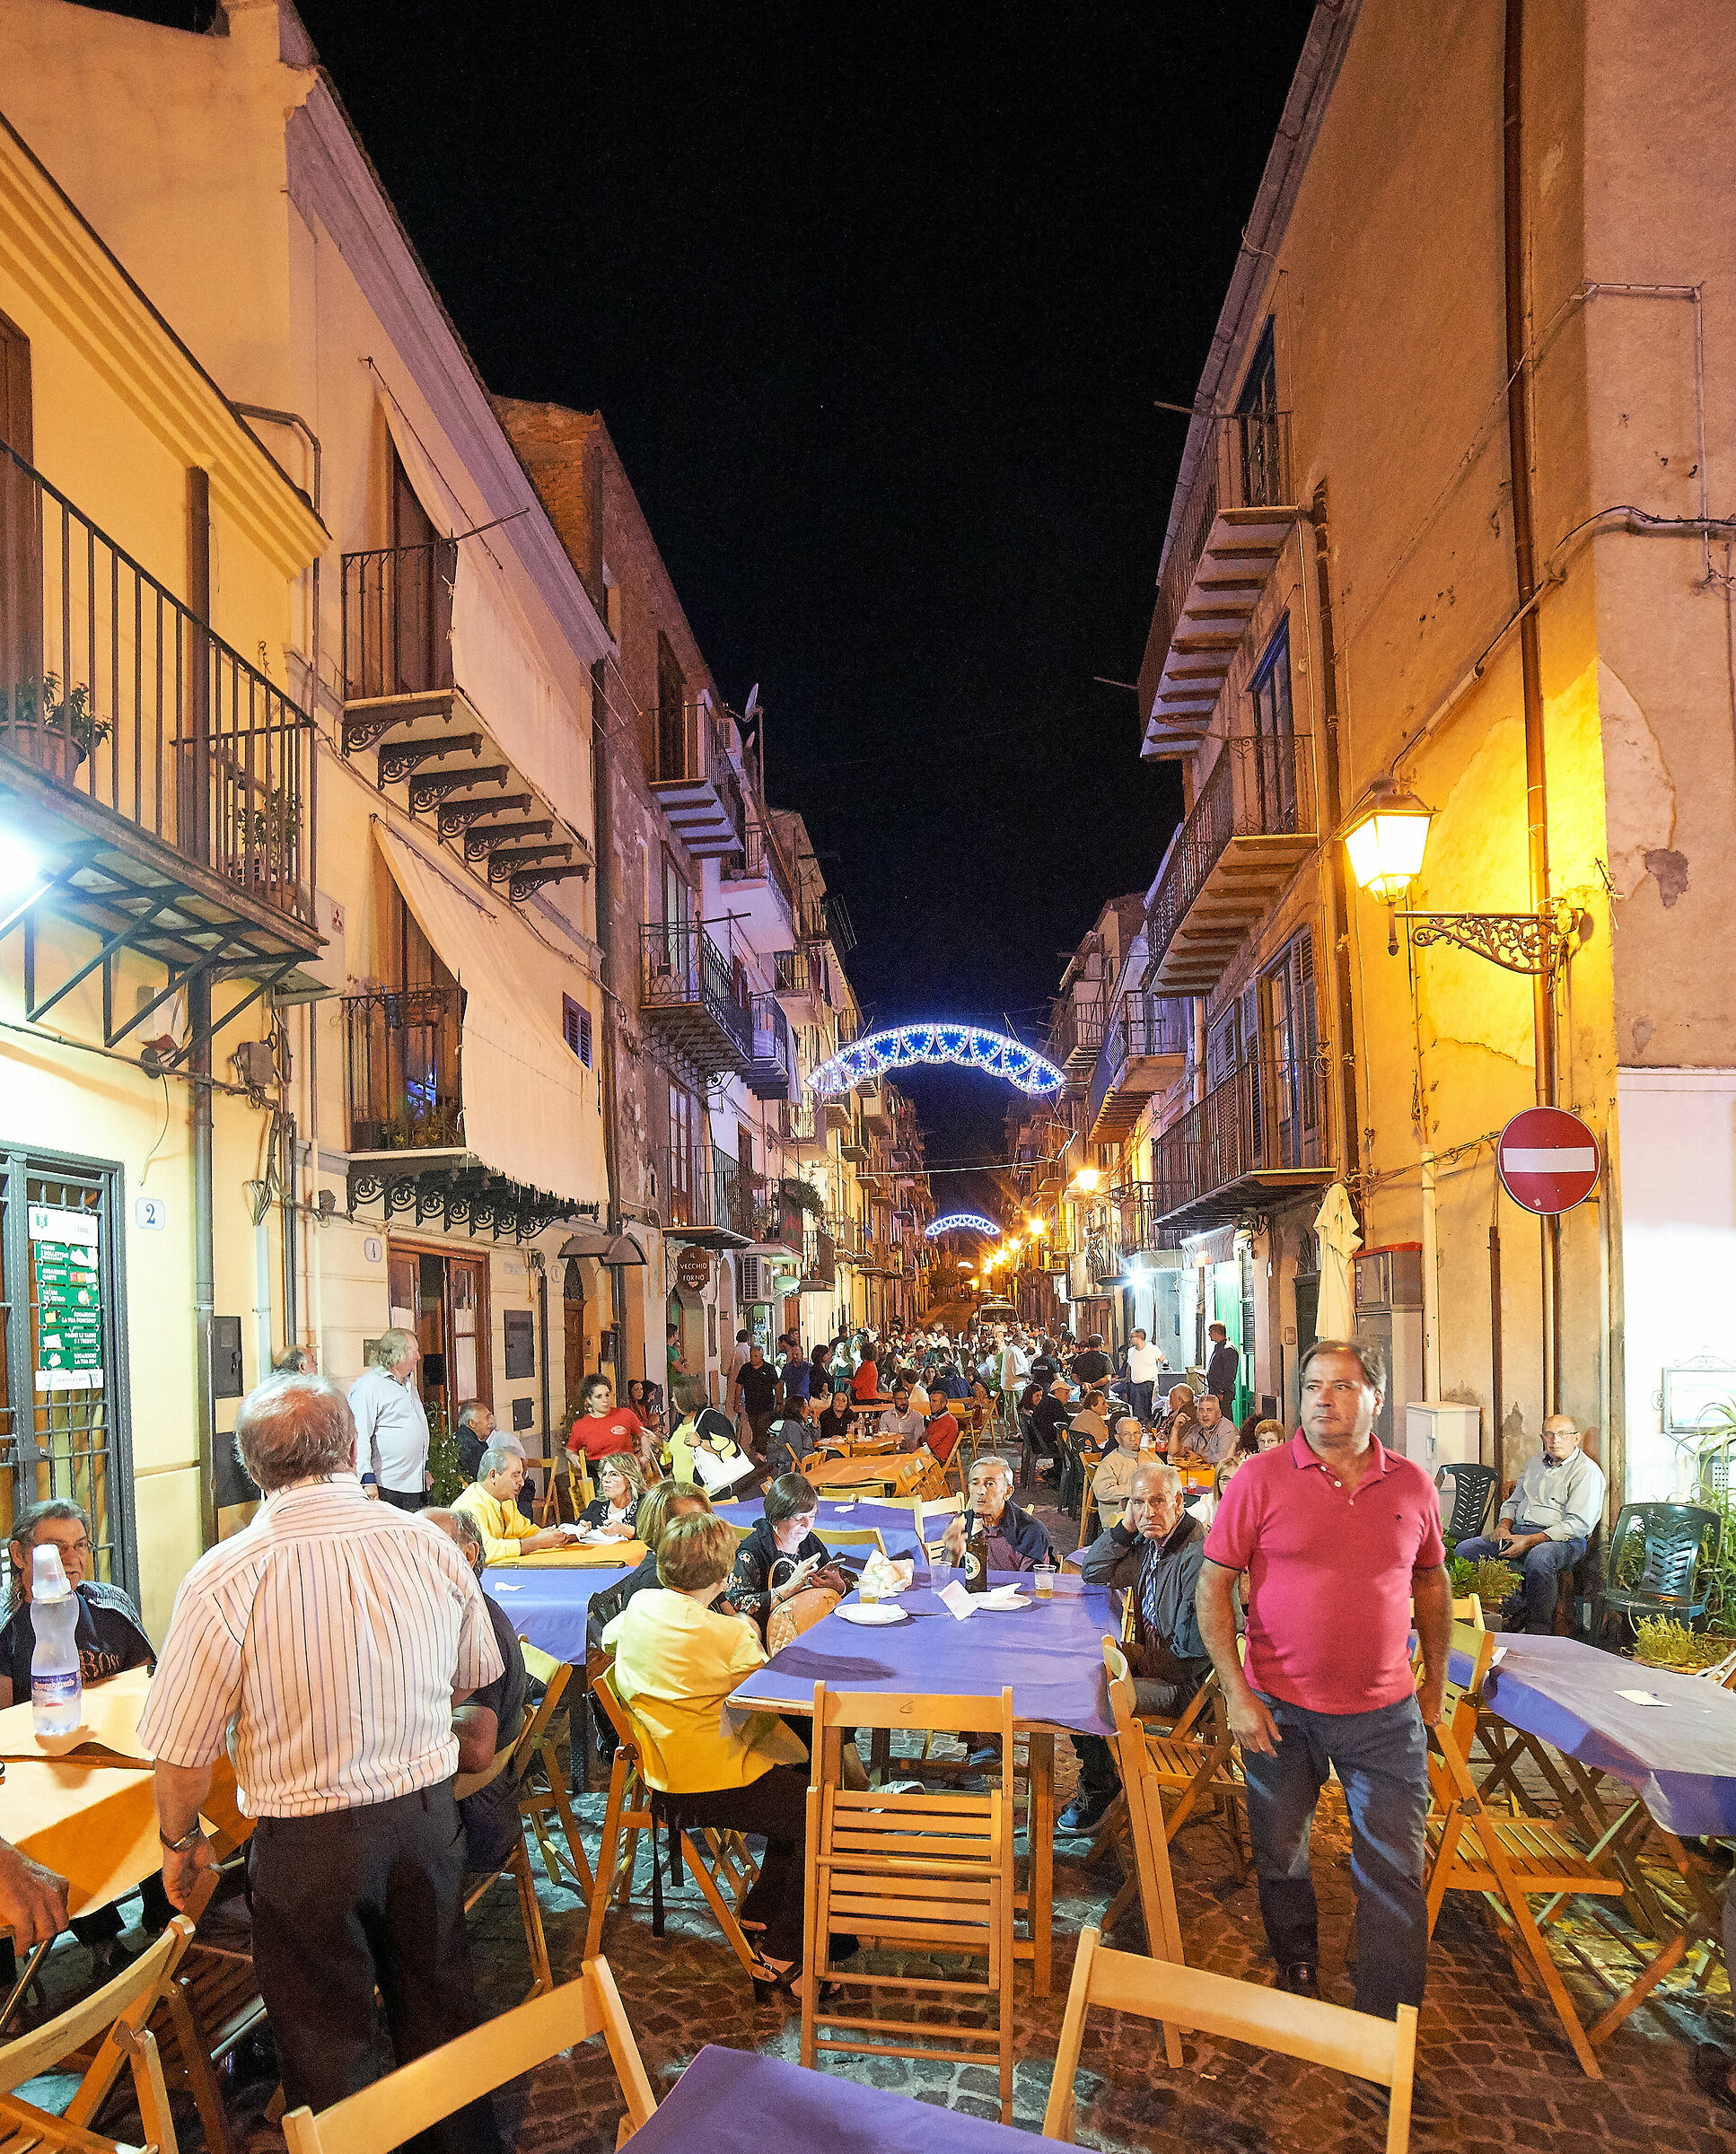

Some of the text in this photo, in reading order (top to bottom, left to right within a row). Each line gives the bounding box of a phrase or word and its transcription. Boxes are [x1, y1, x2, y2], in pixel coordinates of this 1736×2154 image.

[145, 1203, 155, 1224] 2
[679, 1262, 707, 1270] VECCHIO
[682, 1274, 705, 1282] FORNO
